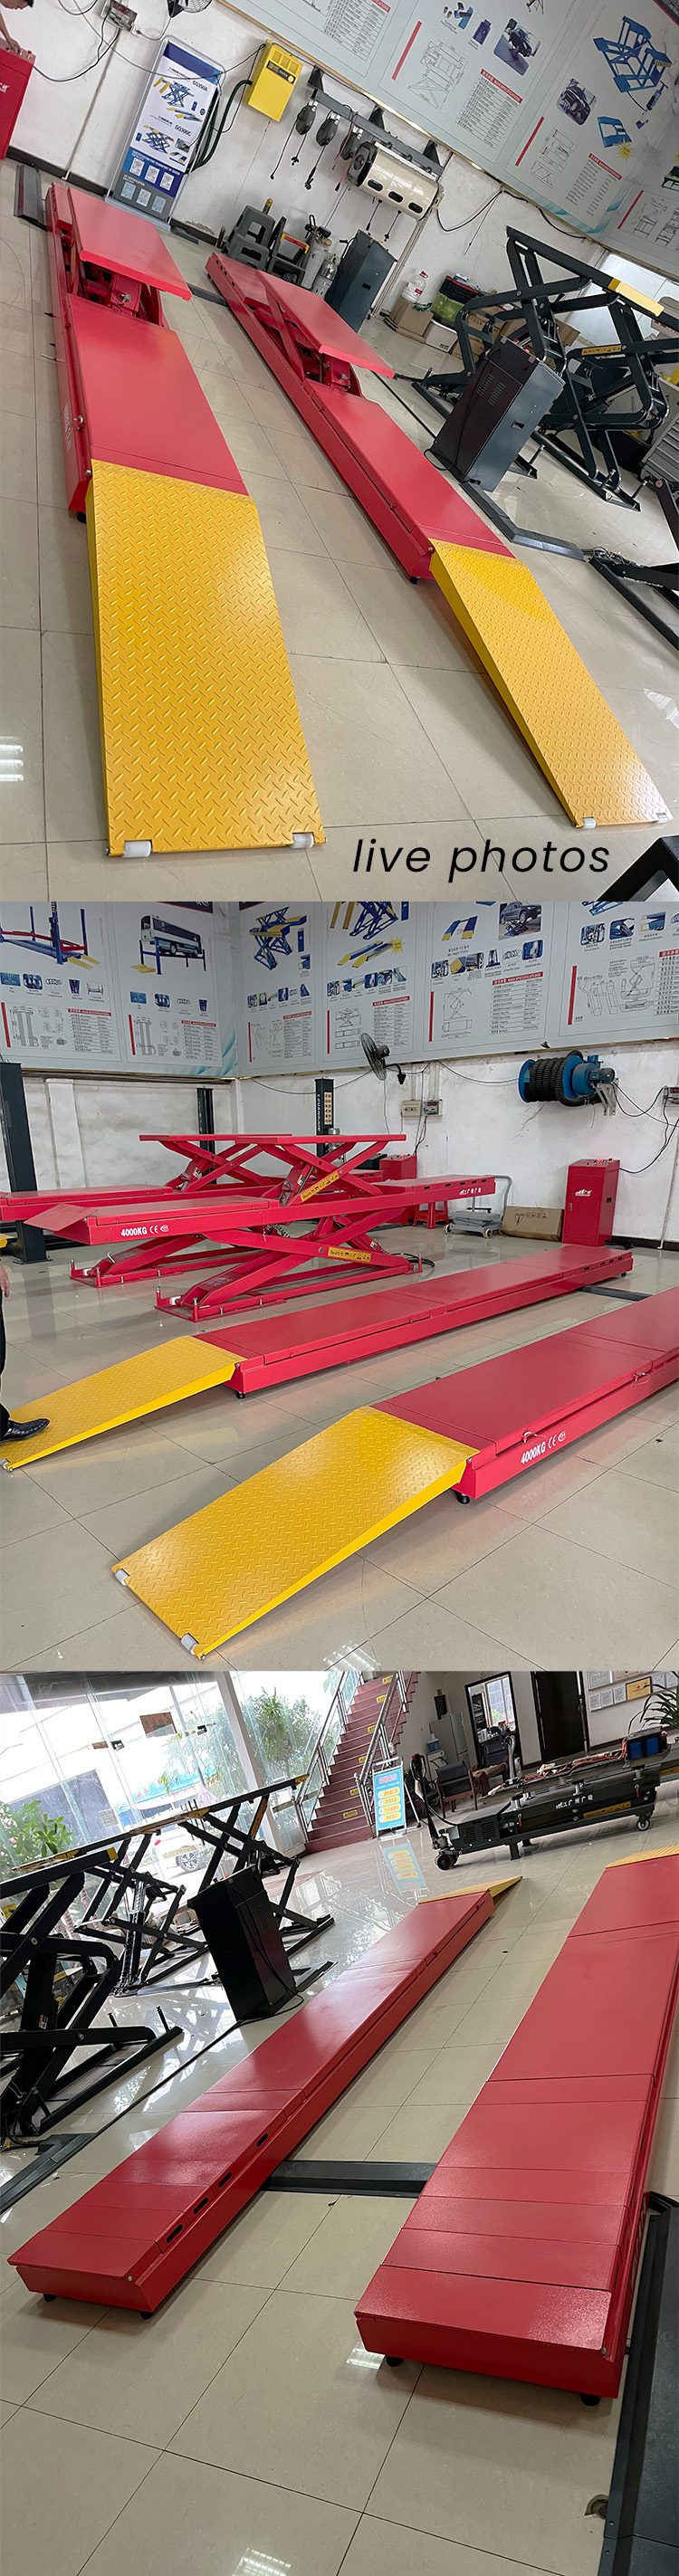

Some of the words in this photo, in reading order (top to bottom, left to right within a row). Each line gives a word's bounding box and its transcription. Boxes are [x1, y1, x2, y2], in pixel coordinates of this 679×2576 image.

[121, 1226, 148, 1236] 4000KG
[149, 1226, 158, 1234] CE
[521, 1441, 546, 1465] 4000KG
[549, 1435, 557, 1448] CE
